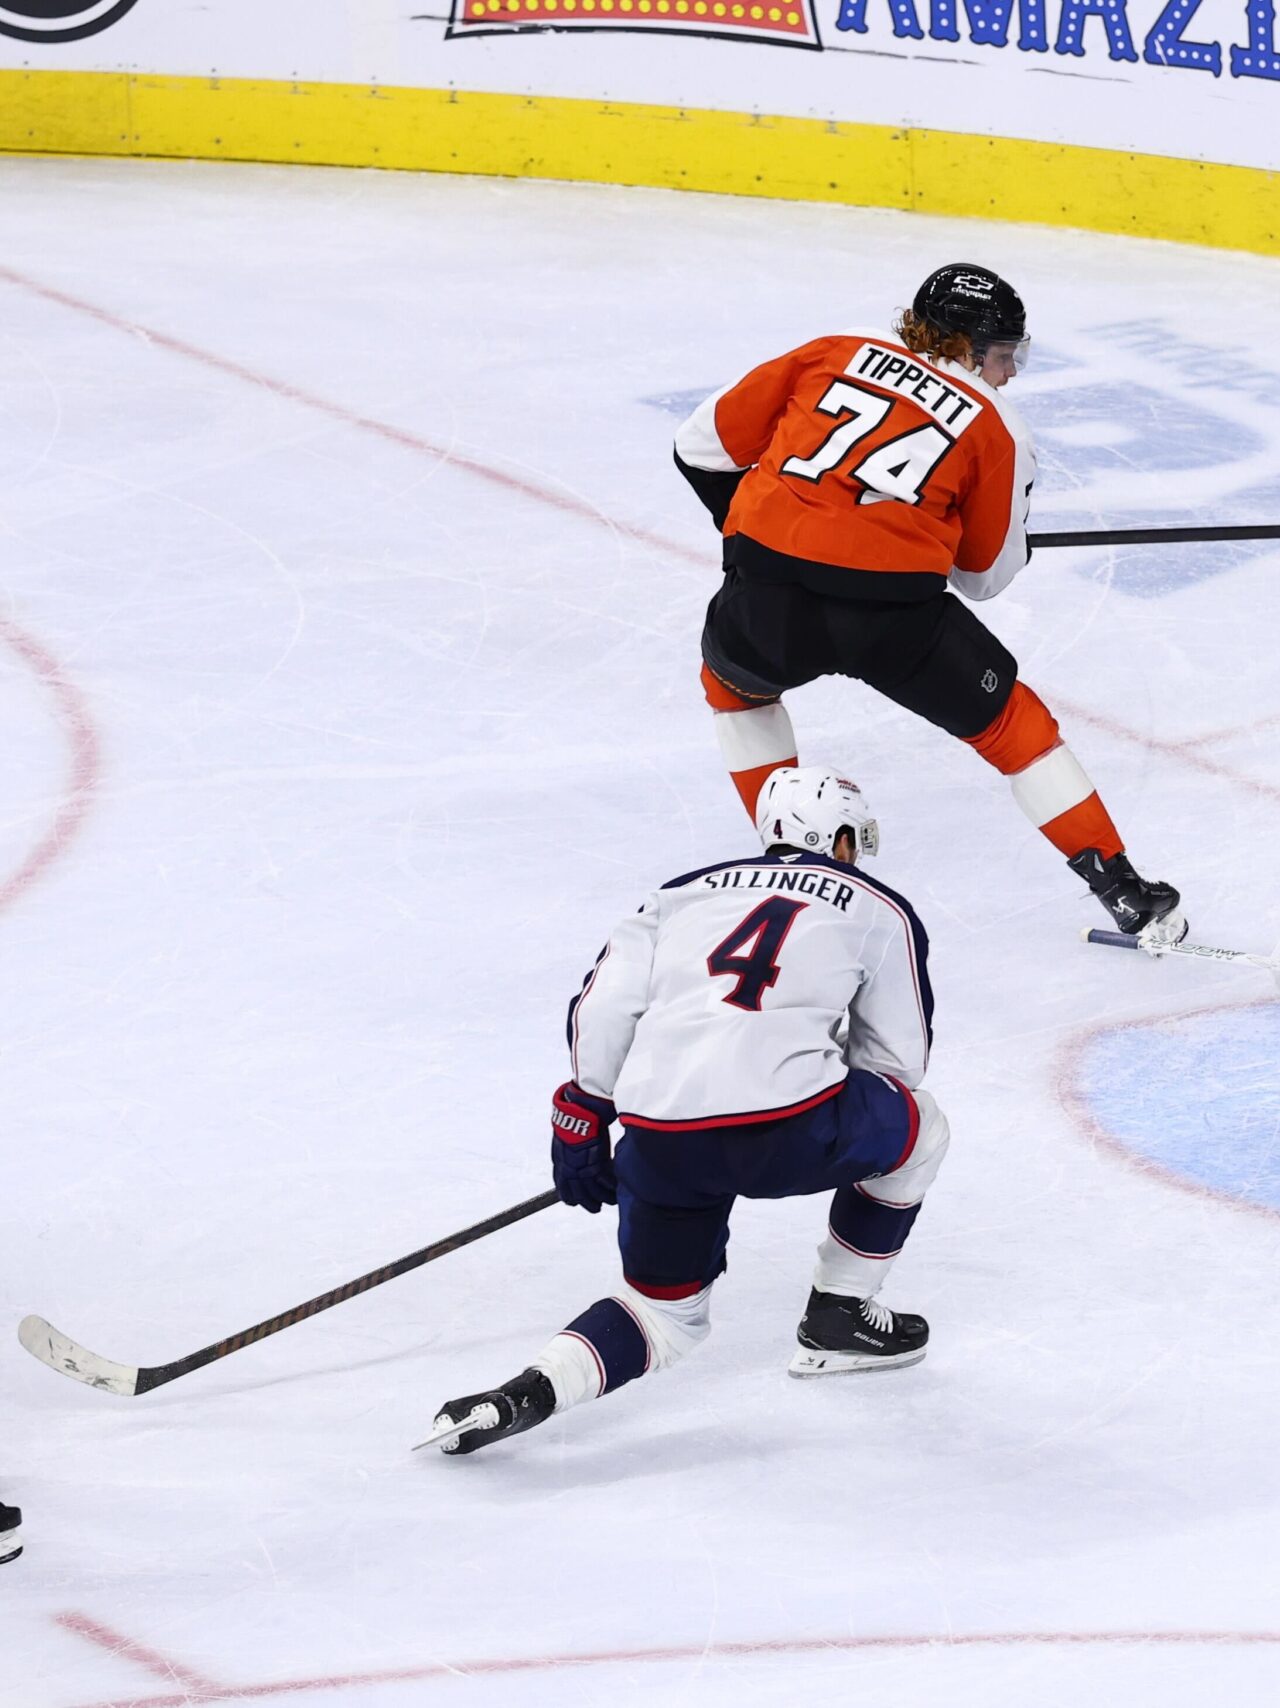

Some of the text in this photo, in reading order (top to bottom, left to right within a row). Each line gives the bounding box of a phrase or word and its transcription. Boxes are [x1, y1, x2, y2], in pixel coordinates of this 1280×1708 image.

[857, 347, 973, 425] TIPPETT
[778, 377, 958, 507] 74
[705, 871, 854, 912] SILLINGER
[706, 895, 811, 1011] 4
[852, 1331, 885, 1348] BAUER
